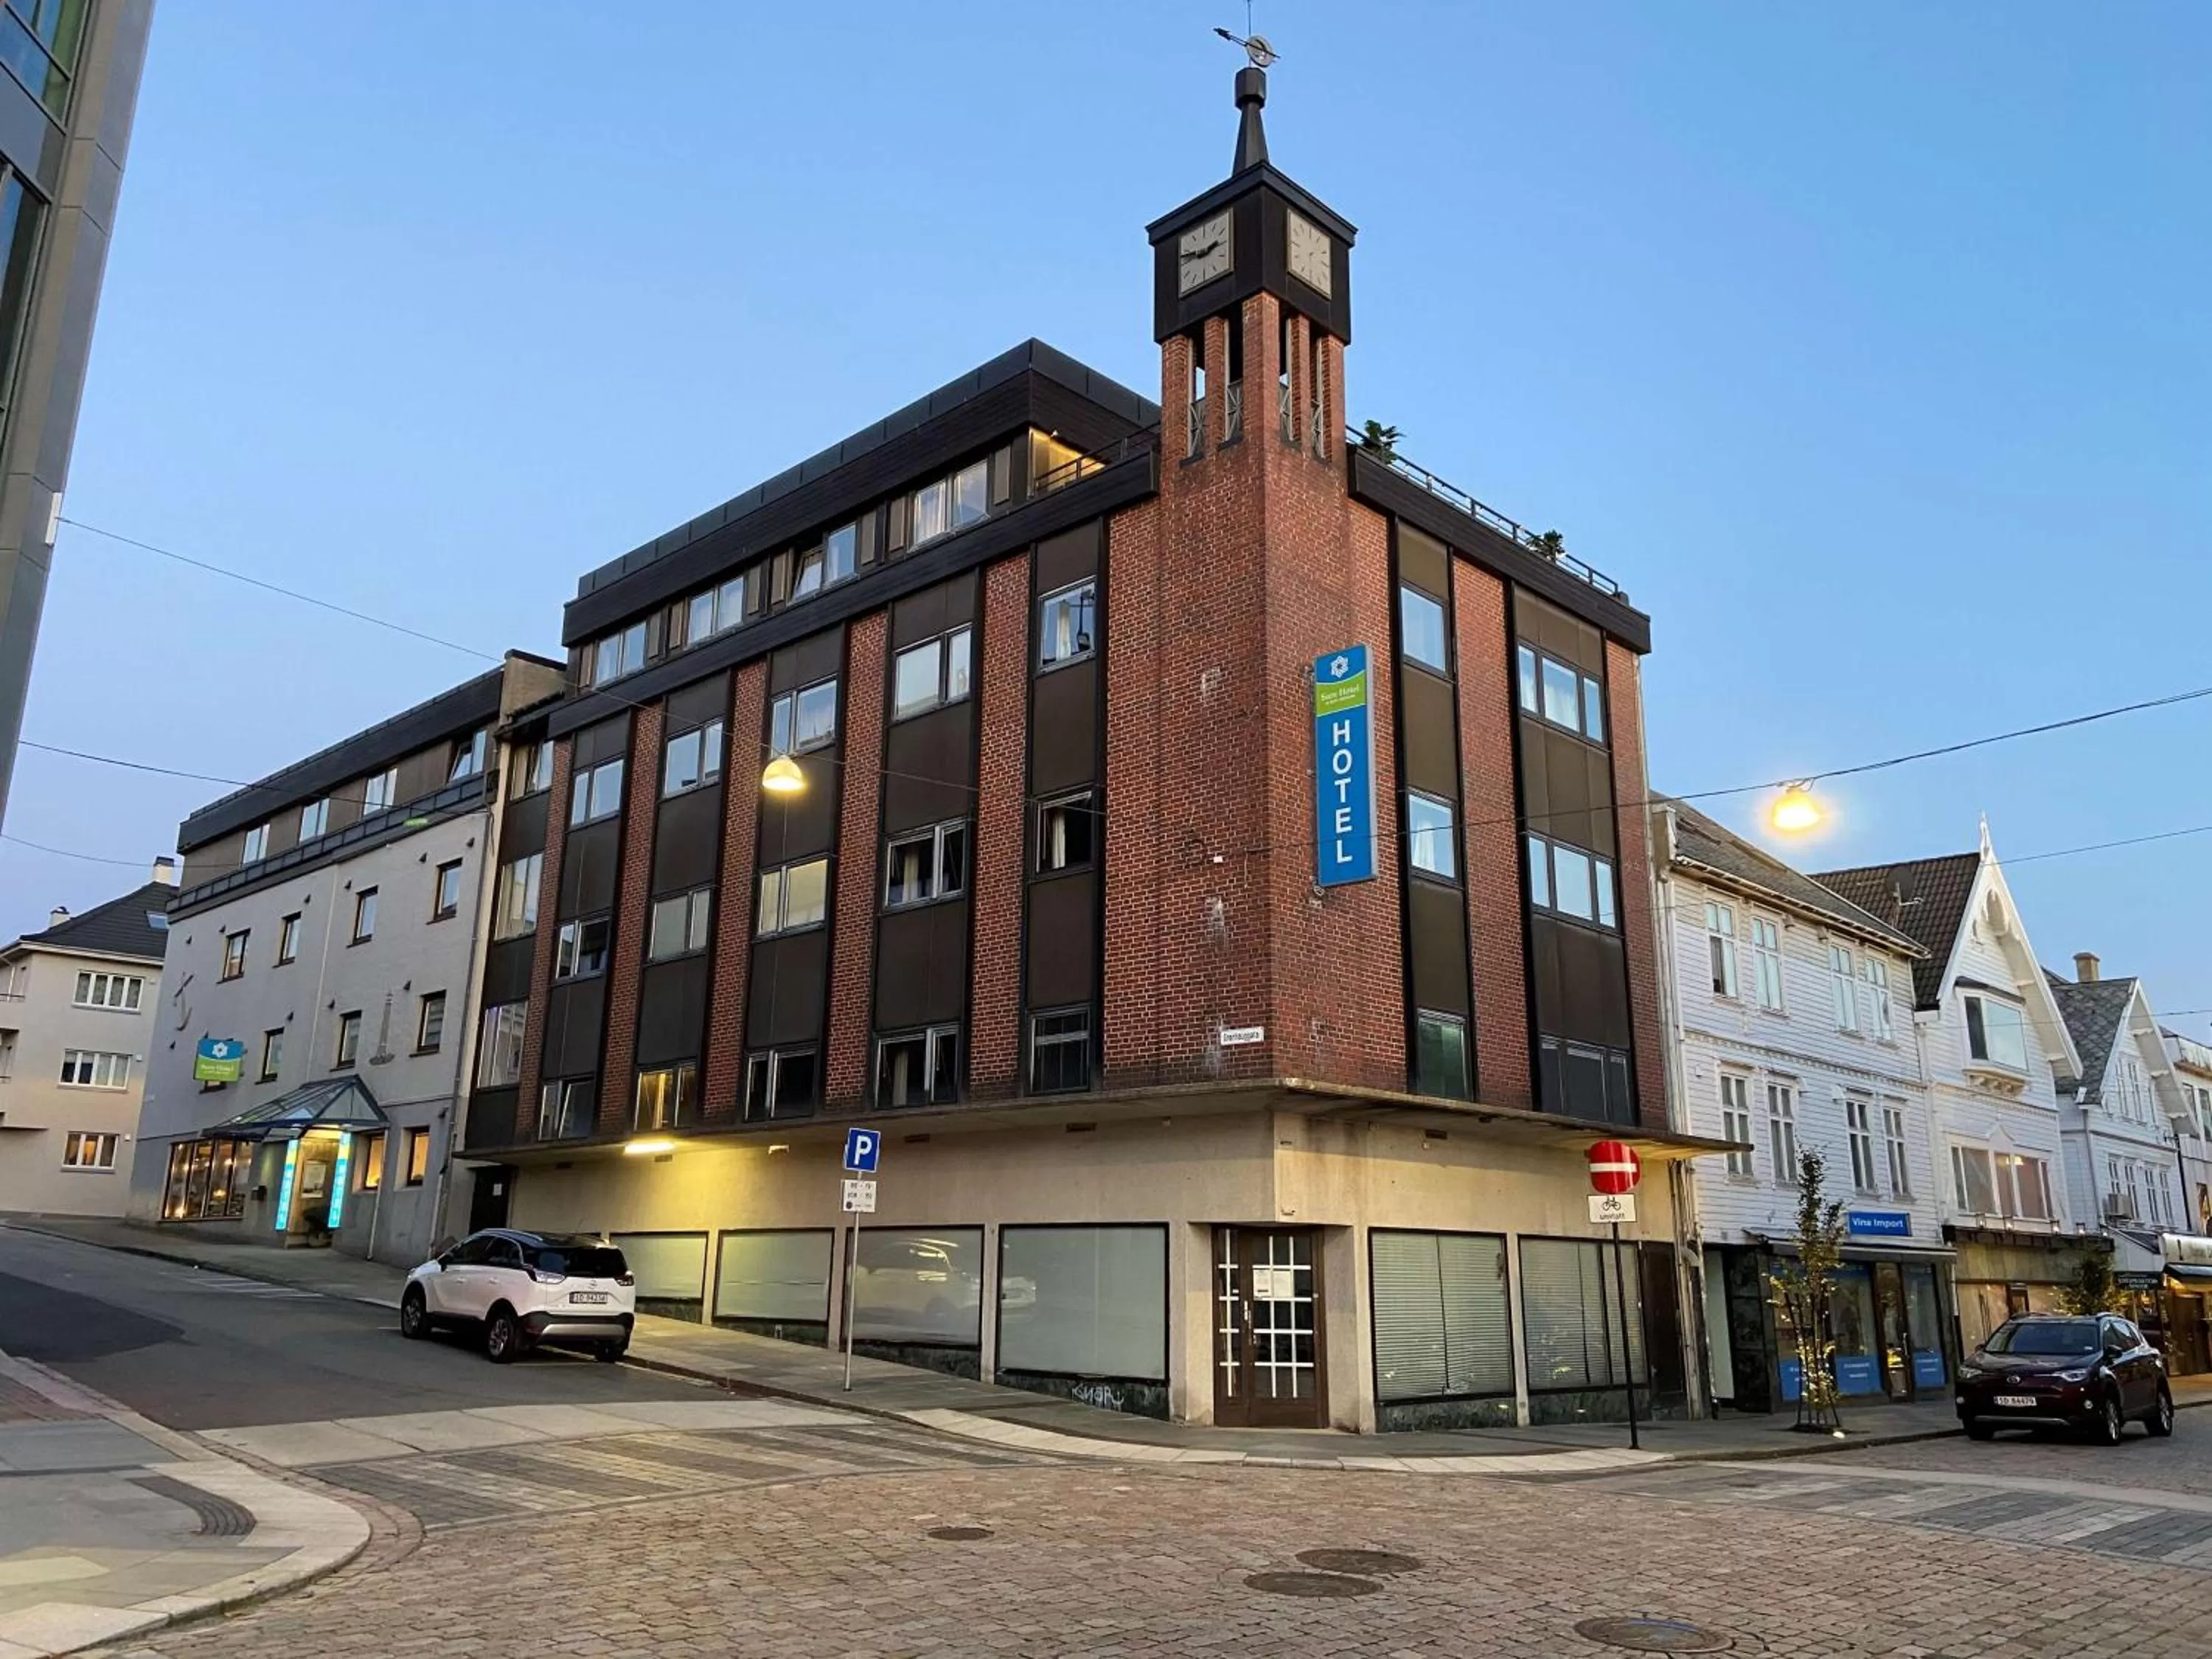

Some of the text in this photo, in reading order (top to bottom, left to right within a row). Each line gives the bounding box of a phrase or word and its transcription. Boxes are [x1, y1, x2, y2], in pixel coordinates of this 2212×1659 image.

[1332, 719, 1353, 863] HOTEL
[854, 1135, 873, 1166] P
[1873, 1218, 1904, 1228] Import
